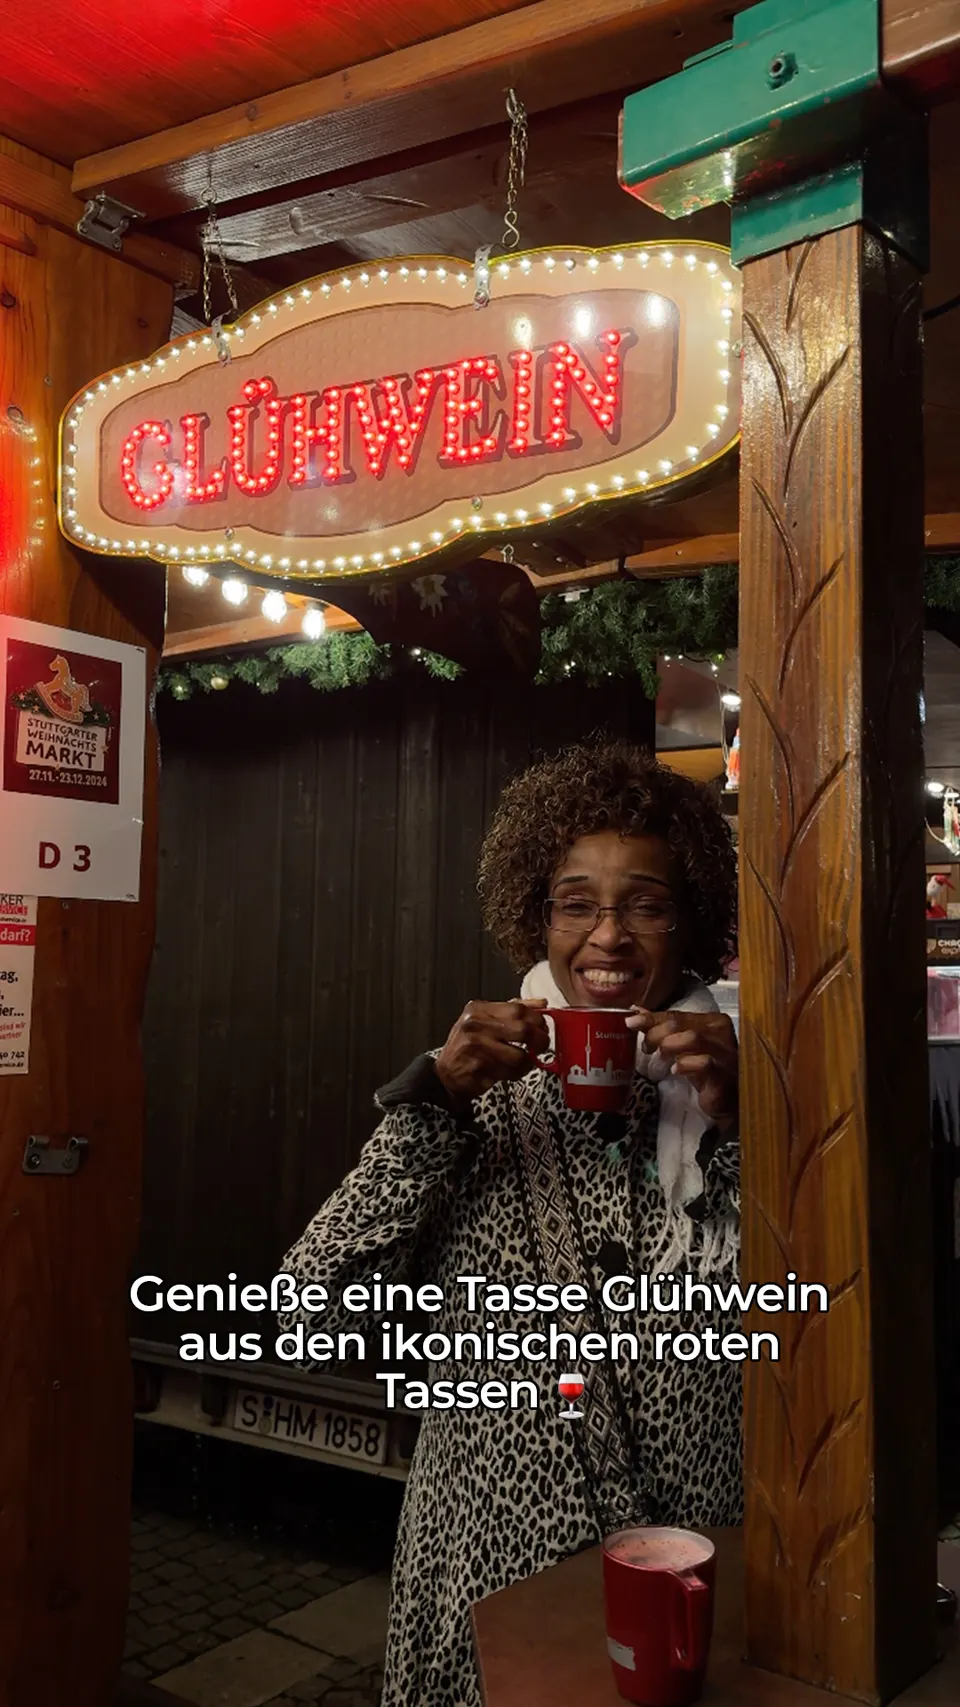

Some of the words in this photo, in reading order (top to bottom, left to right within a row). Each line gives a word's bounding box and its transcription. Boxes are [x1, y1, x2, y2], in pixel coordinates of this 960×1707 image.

[119, 327, 635, 512] GLÜHWEIN
[27, 728, 97, 752] WEIHNACHTS
[28, 718, 98, 741] STUTTGARTER
[26, 740, 96, 769] MARKT
[38, 841, 61, 869] D
[72, 844, 92, 872] 3
[0, 928, 31, 942] darf?
[0, 970, 18, 984] ag,
[241, 1395, 258, 1427] S
[274, 1401, 317, 1442] HM
[324, 1412, 381, 1457] 1858
